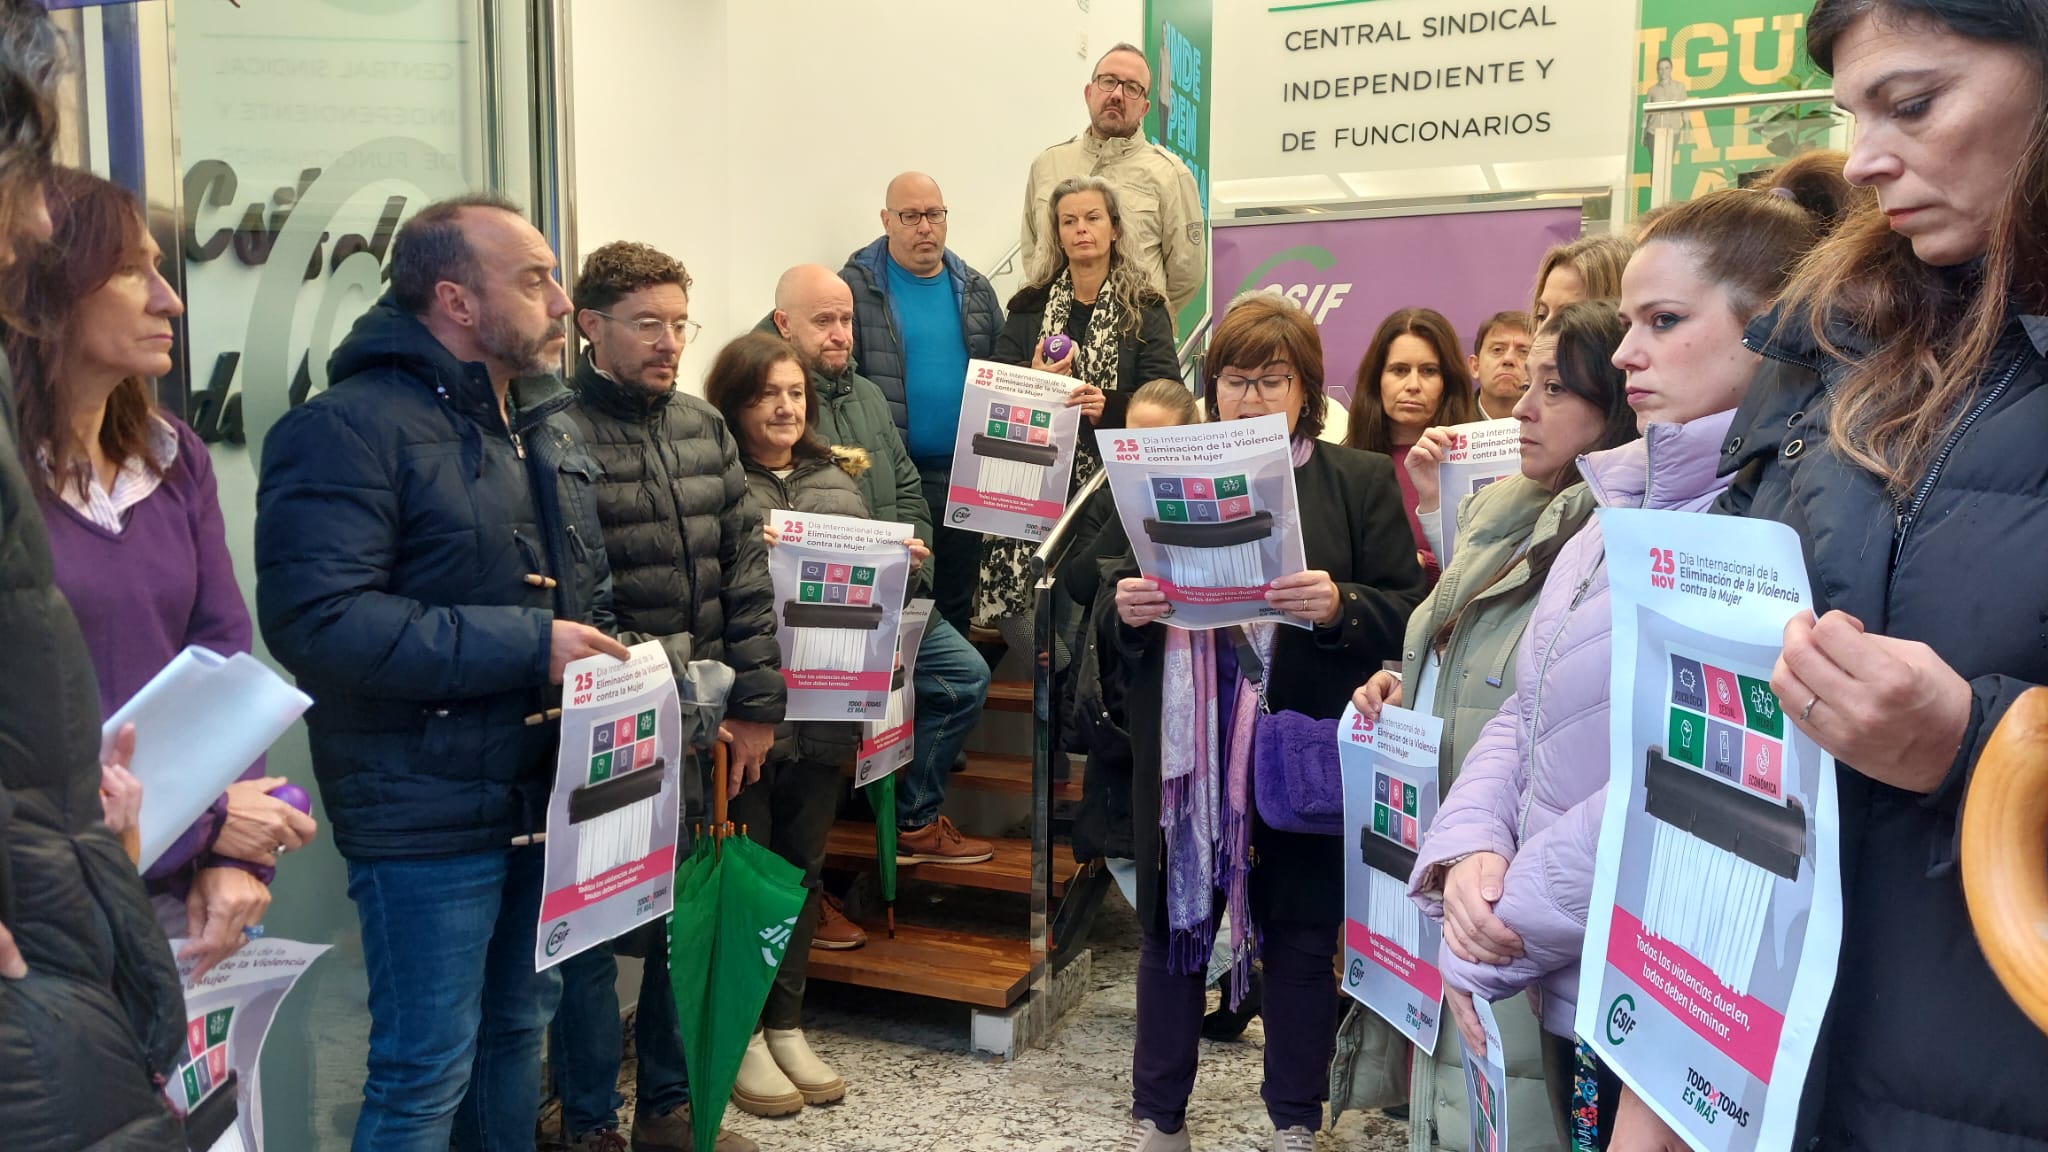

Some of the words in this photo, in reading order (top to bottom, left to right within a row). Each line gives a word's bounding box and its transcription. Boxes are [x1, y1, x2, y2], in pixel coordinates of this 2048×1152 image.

[1285, 20, 1411, 52] CENTRAL
[1422, 5, 1557, 38] SINDICAL
[1284, 61, 1525, 102] INDEPENDIENTE
[1536, 58, 1554, 79] Y
[1167, 91, 1197, 157] PEN
[1282, 130, 1316, 152] DE
[1335, 112, 1550, 148] FUNCIONARIOS
[977, 368, 994, 379] 25
[1009, 371, 1050, 384] Internacional
[996, 377, 1033, 389] Eliminación
[1143, 437, 1159, 445] Día
[1161, 431, 1228, 444] Internacional
[1231, 428, 1243, 437] de
[1245, 427, 1255, 436] la
[1471, 431, 1485, 440] Día
[1486, 427, 1520, 437] Internac
[1113, 438, 1139, 453] 25
[1145, 442, 1204, 454] Eliminación
[1206, 442, 1220, 451] de
[1222, 441, 1232, 449] la
[1234, 433, 1284, 448] Violencia
[1451, 434, 1468, 451] 25
[1147, 454, 1180, 462] contra
[1182, 453, 1192, 462] la
[1194, 453, 1224, 462] Mujer
[1449, 452, 1468, 462] NOV
[1472, 451, 1497, 460] contra
[784, 520, 804, 534] 25
[808, 521, 820, 529] Día
[822, 522, 873, 535] Internacional
[782, 535, 802, 543] NOV
[807, 531, 853, 541] Eliminación
[807, 540, 832, 548] contra
[843, 542, 866, 551] Mujer
[1650, 547, 1675, 575] 25
[1679, 552, 1695, 566] Día
[1696, 554, 1755, 577] Internacional
[1757, 564, 1769, 579] de
[1770, 566, 1778, 582] la
[1651, 574, 1675, 590] NOV
[1680, 568, 1732, 588] Eliminación
[1734, 577, 1745, 591] de
[1746, 579, 1755, 592] la
[1757, 582, 1800, 604] Violencia
[1680, 583, 1708, 598] contra
[1709, 585, 1717, 600] la
[1718, 589, 1743, 607] Mujer
[575, 672, 593, 692] 25
[596, 673, 634, 690] Eliminación
[635, 670, 642, 678] de
[648, 662, 669, 674] Violencia
[574, 693, 592, 705] NOV
[596, 690, 619, 702] contra
[620, 688, 626, 696] la
[627, 682, 644, 694] Mujer
[1352, 713, 1374, 731] 25
[1351, 734, 1374, 744] NOV
[1414, 739, 1437, 754] Violencia
[1715, 761, 1732, 777] DIGITAL
[1748, 774, 1777, 795] ECONÓMICA
[253, 958, 306, 968] Violencia
[1636, 934, 1658, 961] Todas
[1658, 949, 1671, 972] las
[1671, 963, 1712, 1001] violencias
[1713, 992, 1751, 1031] duelen,
[1642, 961, 1664, 989] todas
[1664, 979, 1688, 1008] deben
[1689, 1000, 1731, 1042] terminar.
[1612, 1006, 1637, 1036] CSIF
[1682, 1087, 1696, 1107] ES
[1696, 1096, 1718, 1125] MÁS
